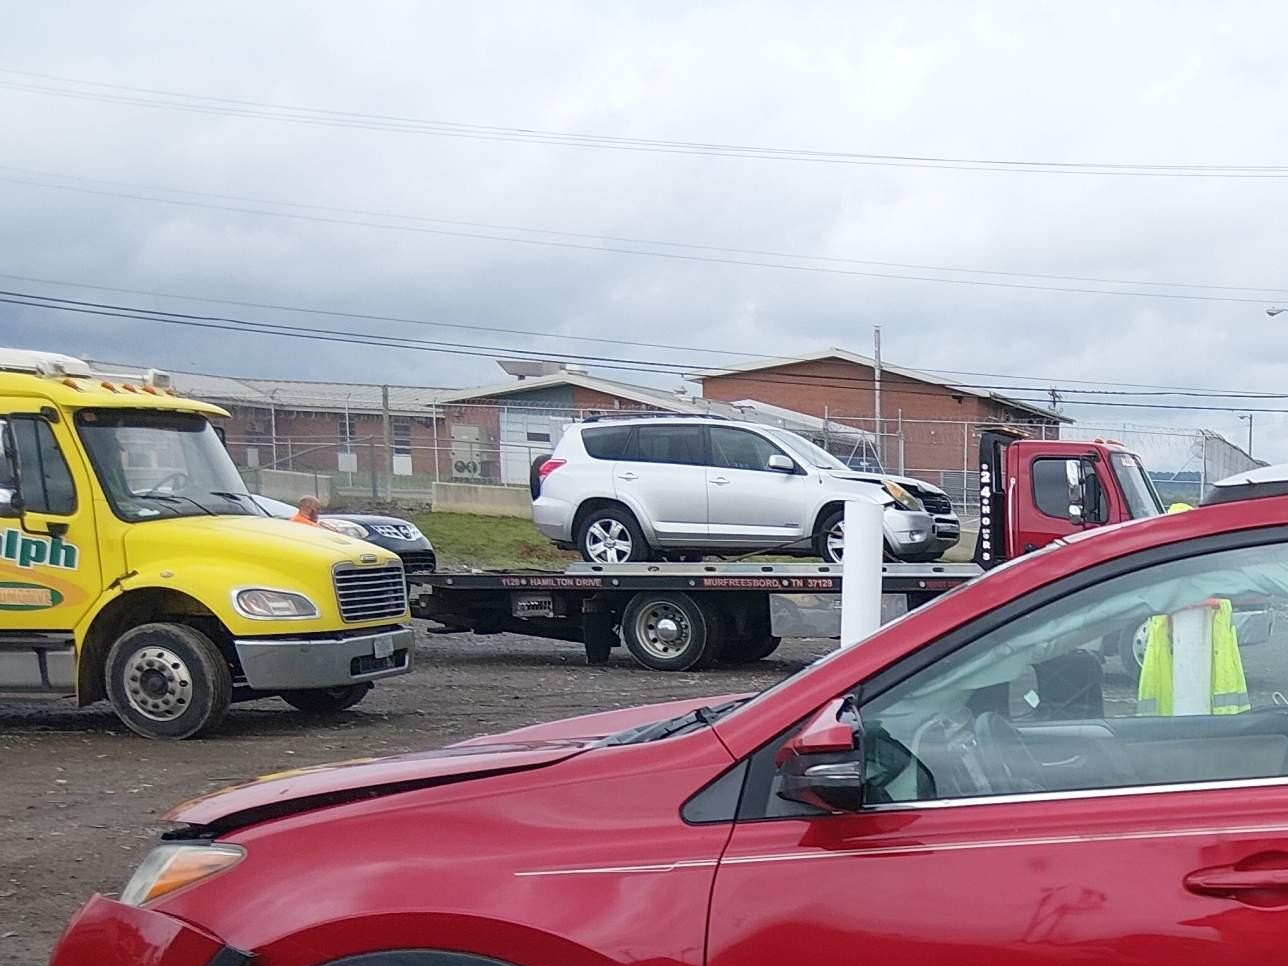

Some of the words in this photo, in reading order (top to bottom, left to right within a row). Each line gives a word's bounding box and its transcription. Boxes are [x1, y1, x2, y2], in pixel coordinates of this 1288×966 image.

[0, 528, 80, 570] lph
[529, 578, 574, 586] HAMILTON
[575, 578, 602, 587] DRIVE
[791, 579, 803, 587] TN
